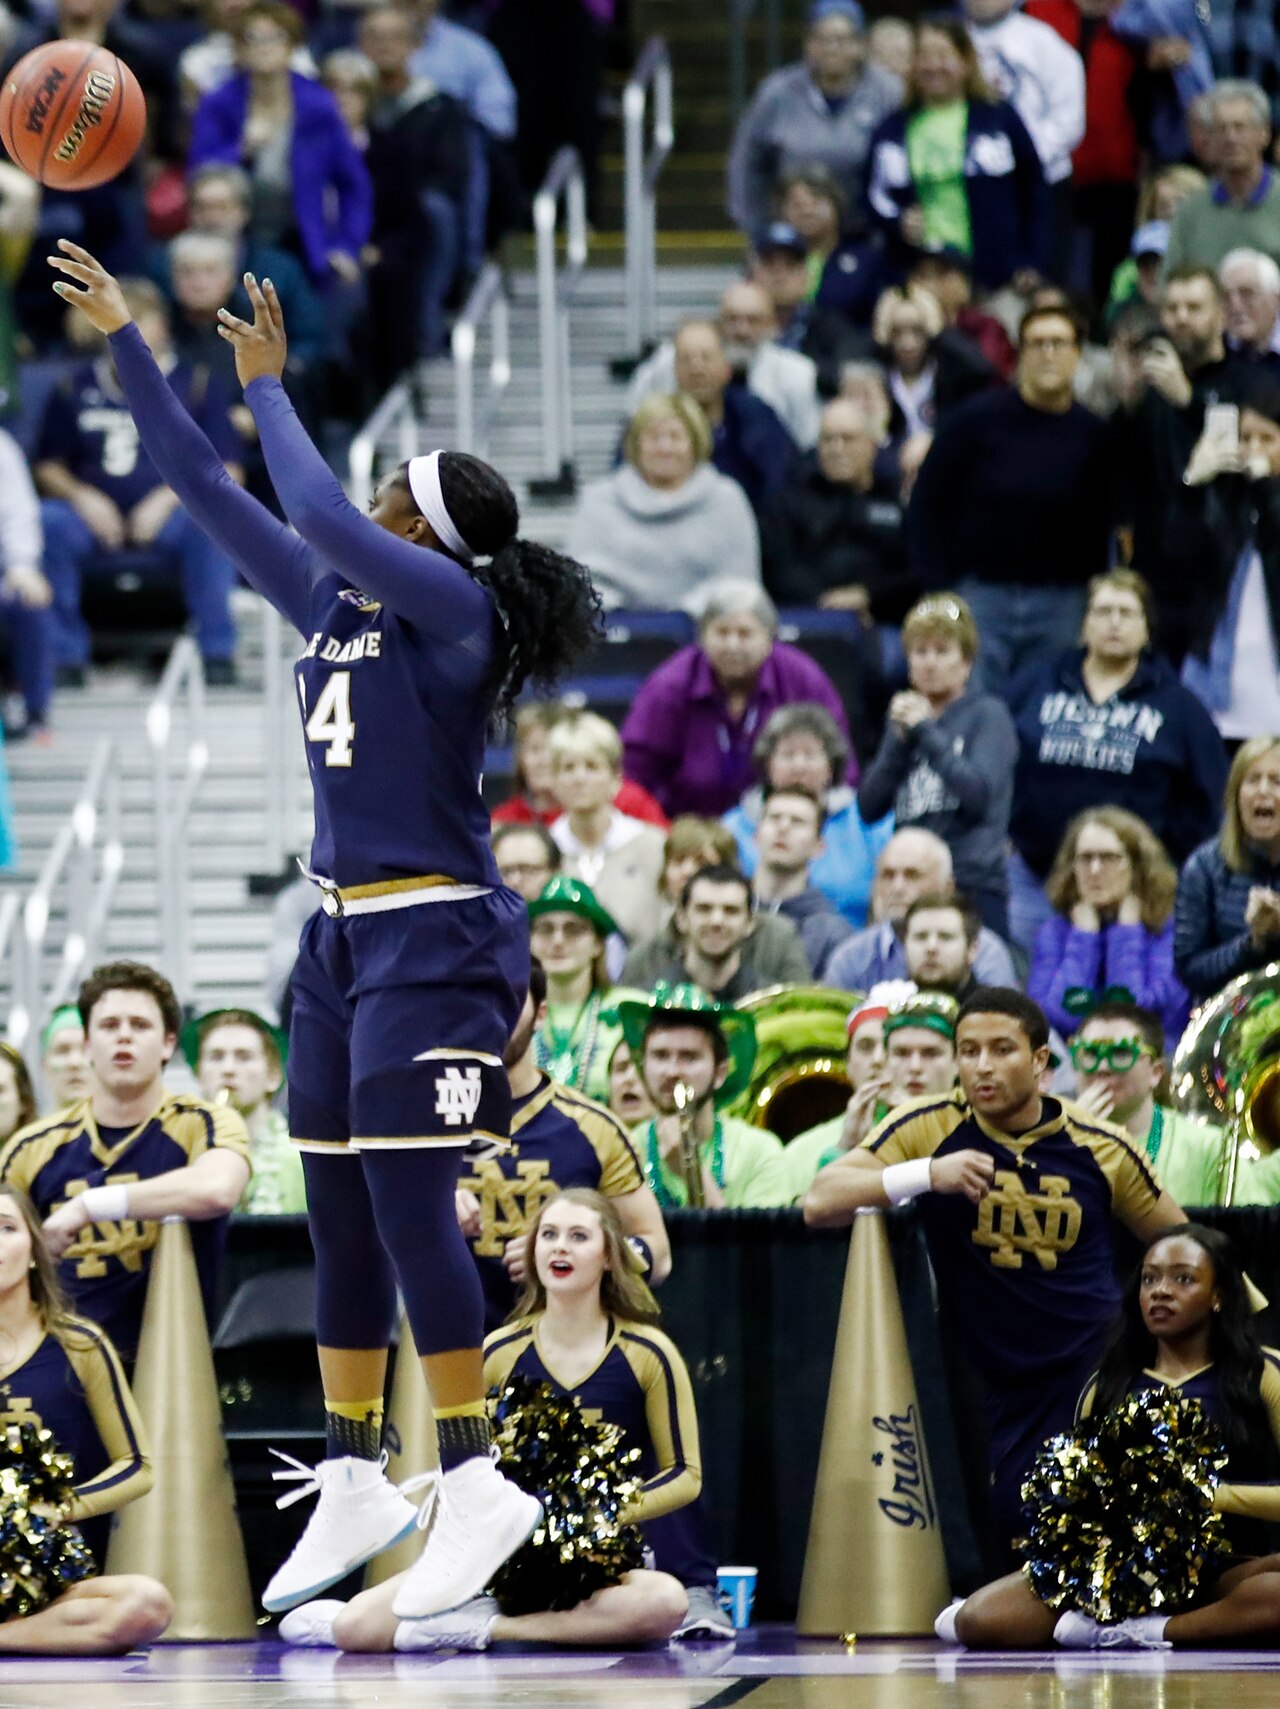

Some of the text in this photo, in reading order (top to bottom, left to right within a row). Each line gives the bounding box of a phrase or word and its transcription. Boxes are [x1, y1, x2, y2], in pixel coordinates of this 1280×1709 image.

[27, 67, 65, 134] NCAA
[54, 71, 115, 163] Wilson
[1039, 692, 1164, 743] UCONN
[972, 1170, 1082, 1270] ND
[871, 1404, 927, 1530] Irish
